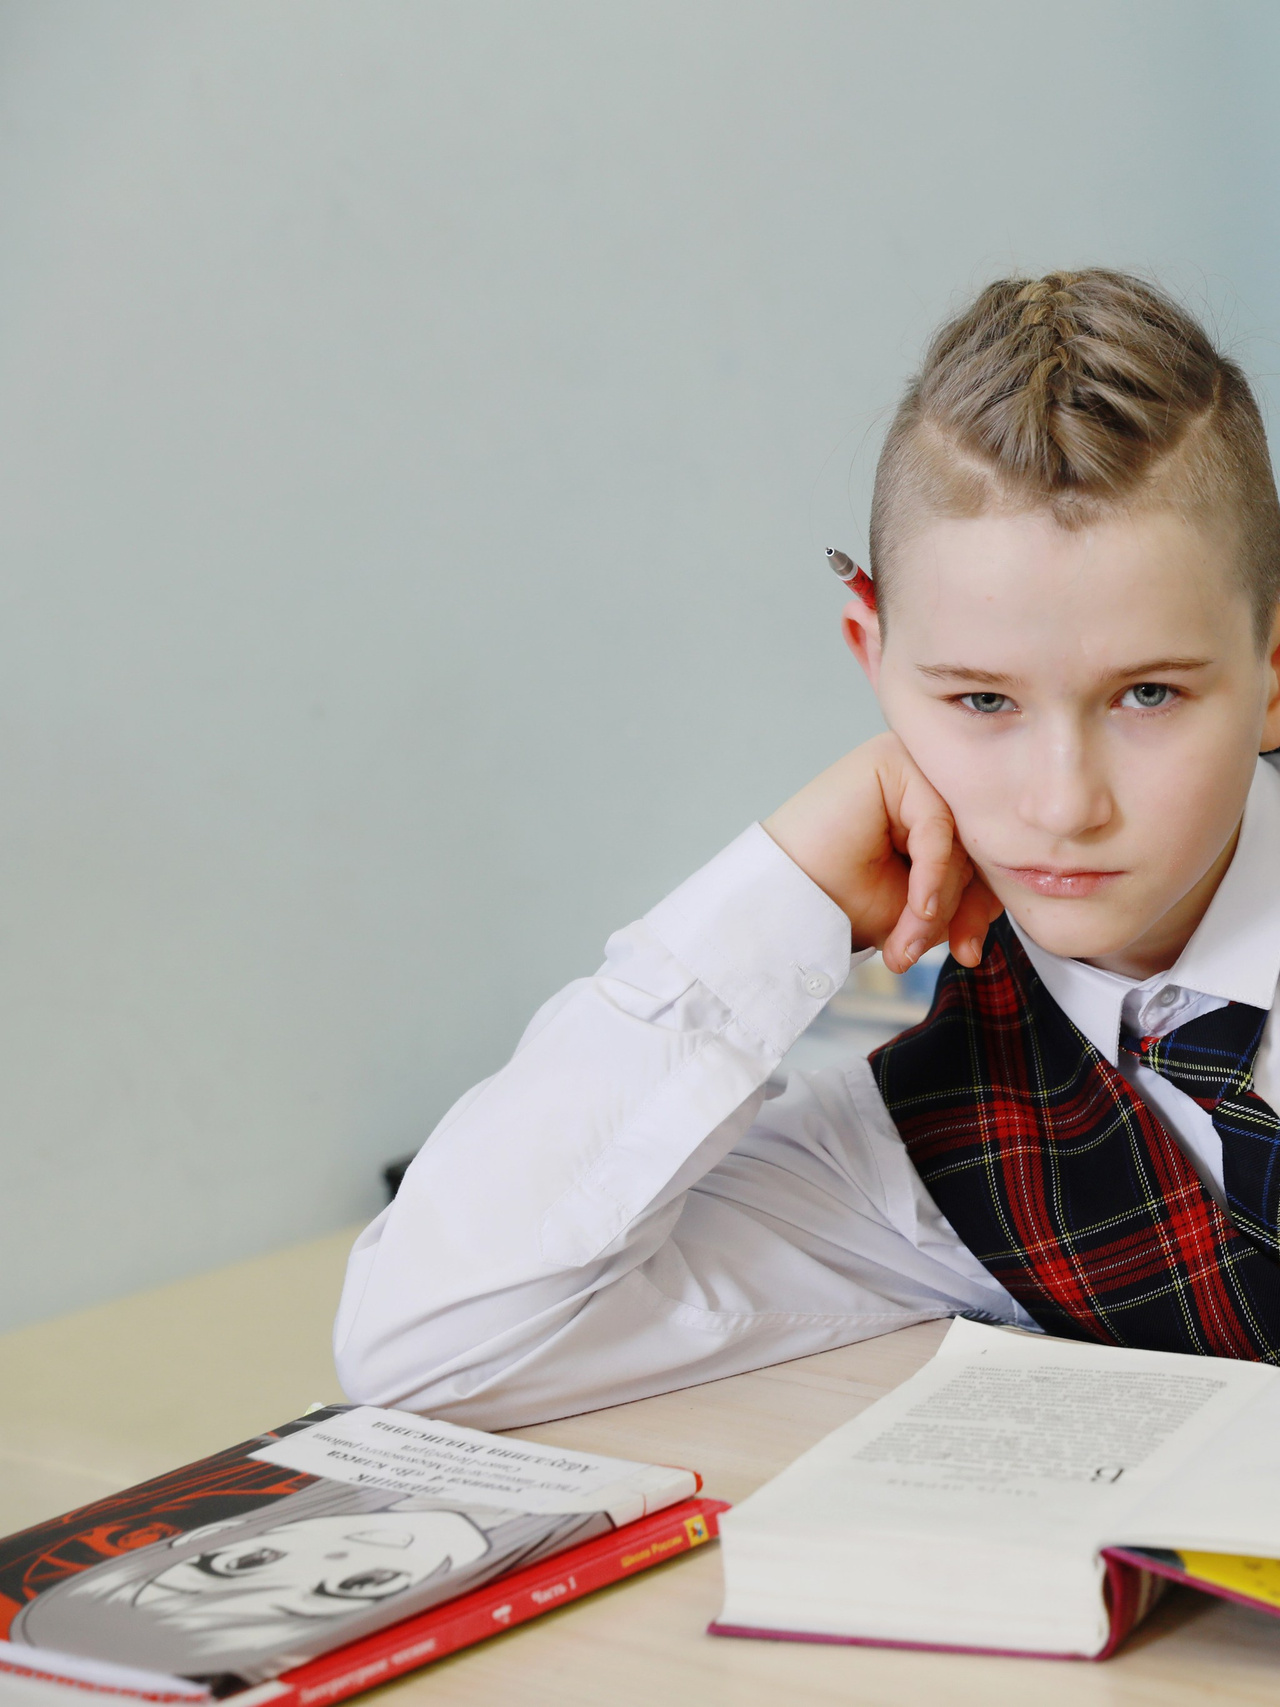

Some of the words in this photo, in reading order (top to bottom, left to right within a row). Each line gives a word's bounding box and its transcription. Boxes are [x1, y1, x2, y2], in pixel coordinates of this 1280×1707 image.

[312, 1432, 362, 1449] района
[371, 1421, 482, 1453] Владислава
[327, 1450, 388, 1469] класса
